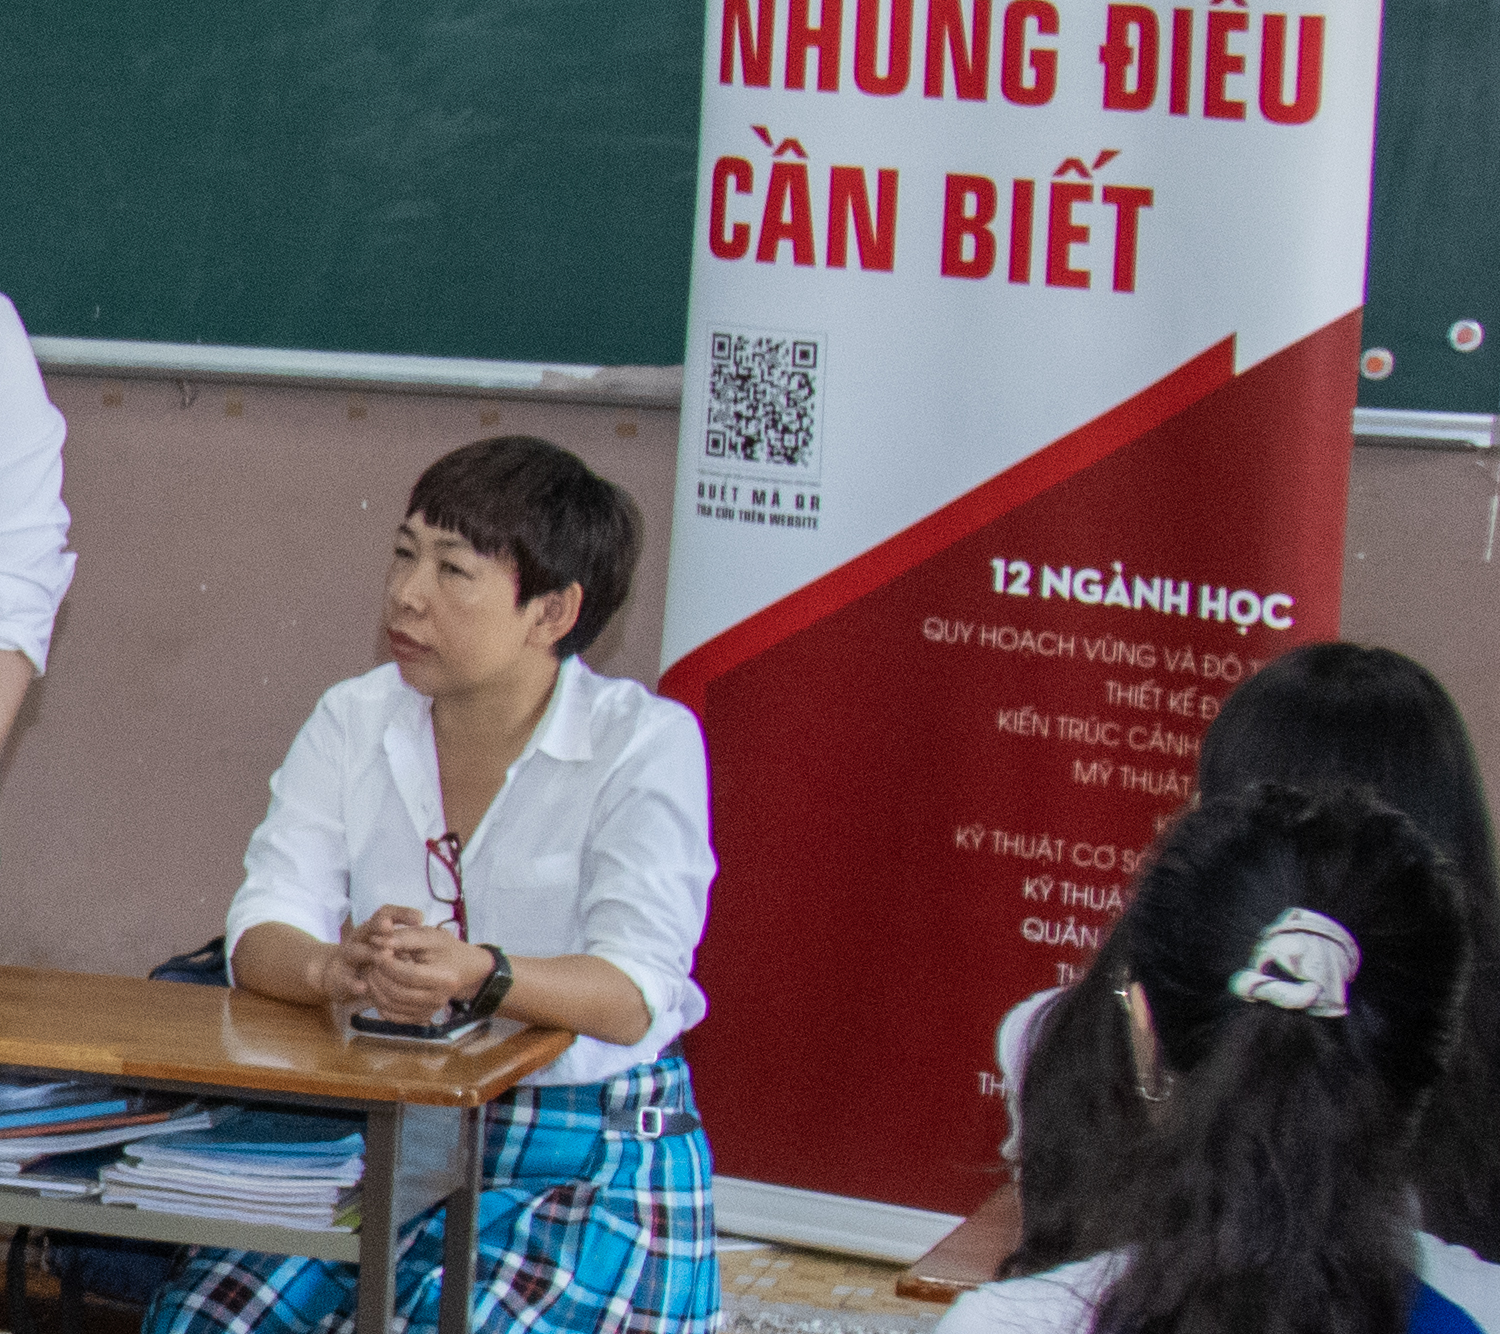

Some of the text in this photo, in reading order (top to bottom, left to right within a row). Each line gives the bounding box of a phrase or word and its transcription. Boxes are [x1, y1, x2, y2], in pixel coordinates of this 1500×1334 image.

[708, 124, 1155, 295] CẦN BIẾT
[991, 558, 1296, 636] 12 NGÀNH HỌC
[921, 615, 974, 644] QUY
[979, 625, 1075, 660] HOẠCH
[1083, 633, 1157, 668] VÙNG
[1163, 641, 1198, 676] VÀ
[1201, 650, 1242, 683] ĐÔ
[1106, 677, 1162, 712] THIẾT
[1167, 686, 1198, 718] KẾ
[998, 705, 1200, 757] KIẾN TRÚC CẢNH
[1072, 758, 1194, 802] MỸ THUẬT
[955, 822, 986, 851] KỸ
[993, 828, 1066, 867] THUẬT
[1071, 841, 1117, 871] CƠ
[1023, 873, 1125, 918] KỸ THUẬ
[1020, 915, 1099, 949] QUẢN
